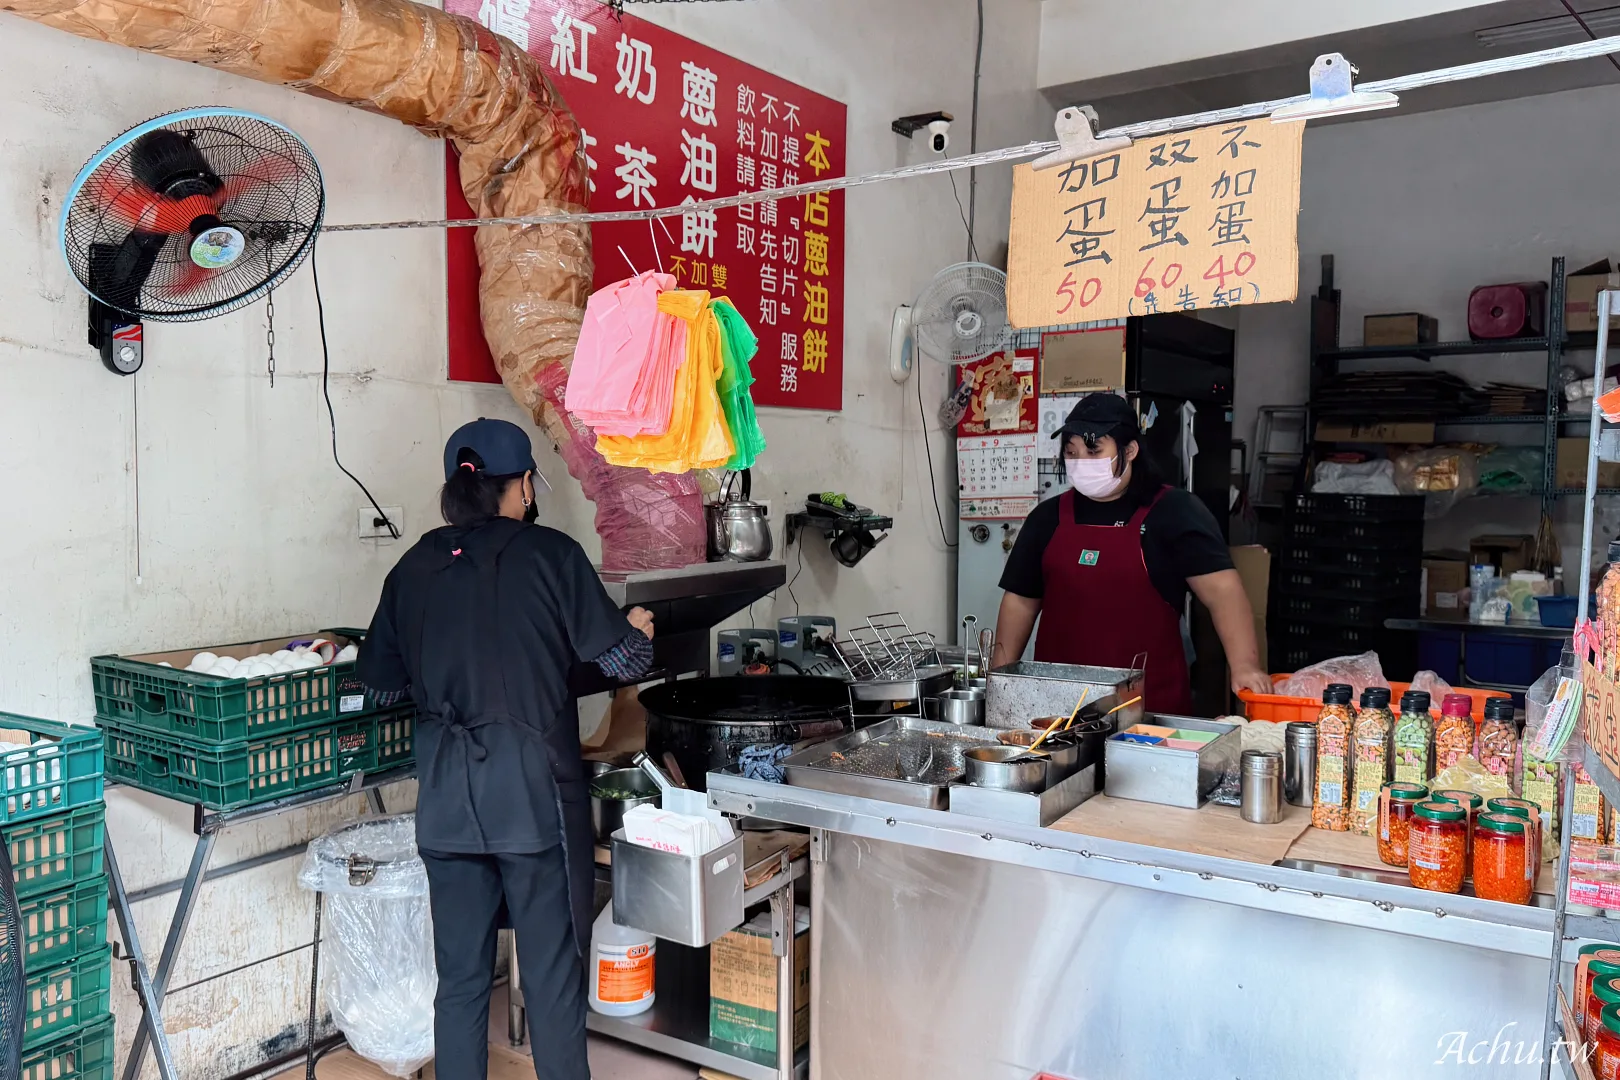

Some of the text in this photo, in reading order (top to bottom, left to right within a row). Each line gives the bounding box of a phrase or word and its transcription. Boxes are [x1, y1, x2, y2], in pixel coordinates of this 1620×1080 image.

[615, 33, 657, 207] 奶茶
[680, 61, 718, 259] 蔥油餅
[736, 83, 756, 256] 飲料請自取
[760, 92, 779, 326] 不加蛋請先告知
[1056, 154, 1121, 268] 加蛋
[1138, 139, 1199, 252] 双蛋
[1208, 125, 1262, 247] 不加蛋
[802, 130, 831, 374] 本店蔥油餅
[1056, 272, 1102, 314] 50
[1134, 257, 1183, 298] 60
[1203, 252, 1257, 288] 40
